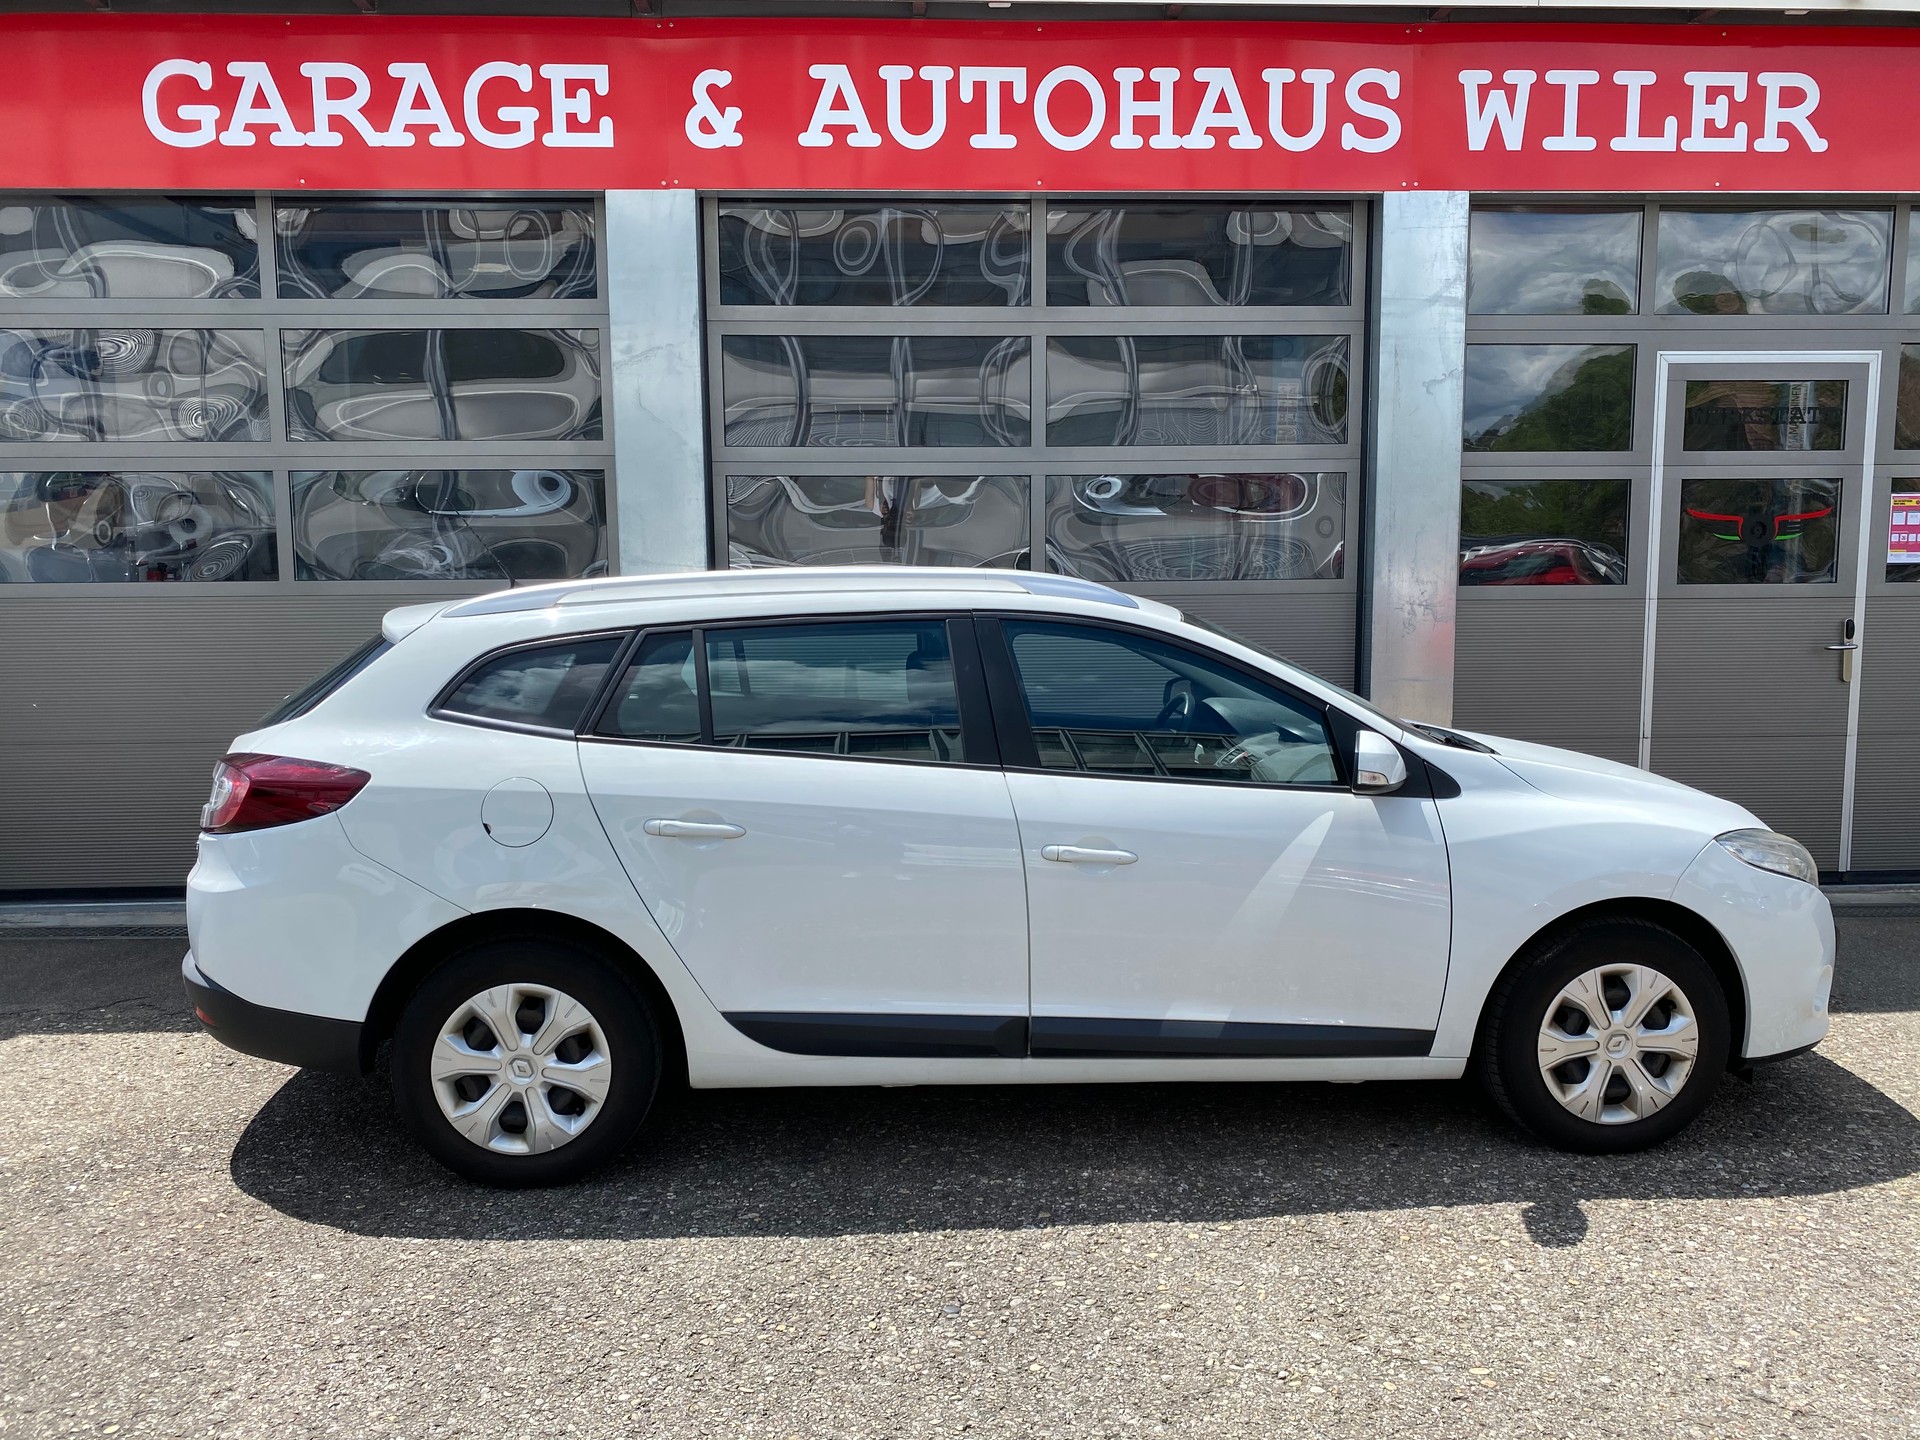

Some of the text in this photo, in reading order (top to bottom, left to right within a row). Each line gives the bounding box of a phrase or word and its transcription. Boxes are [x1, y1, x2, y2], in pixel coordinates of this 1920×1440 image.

[141, 58, 1829, 153] GARAGE & AUTOHAUS WILER
